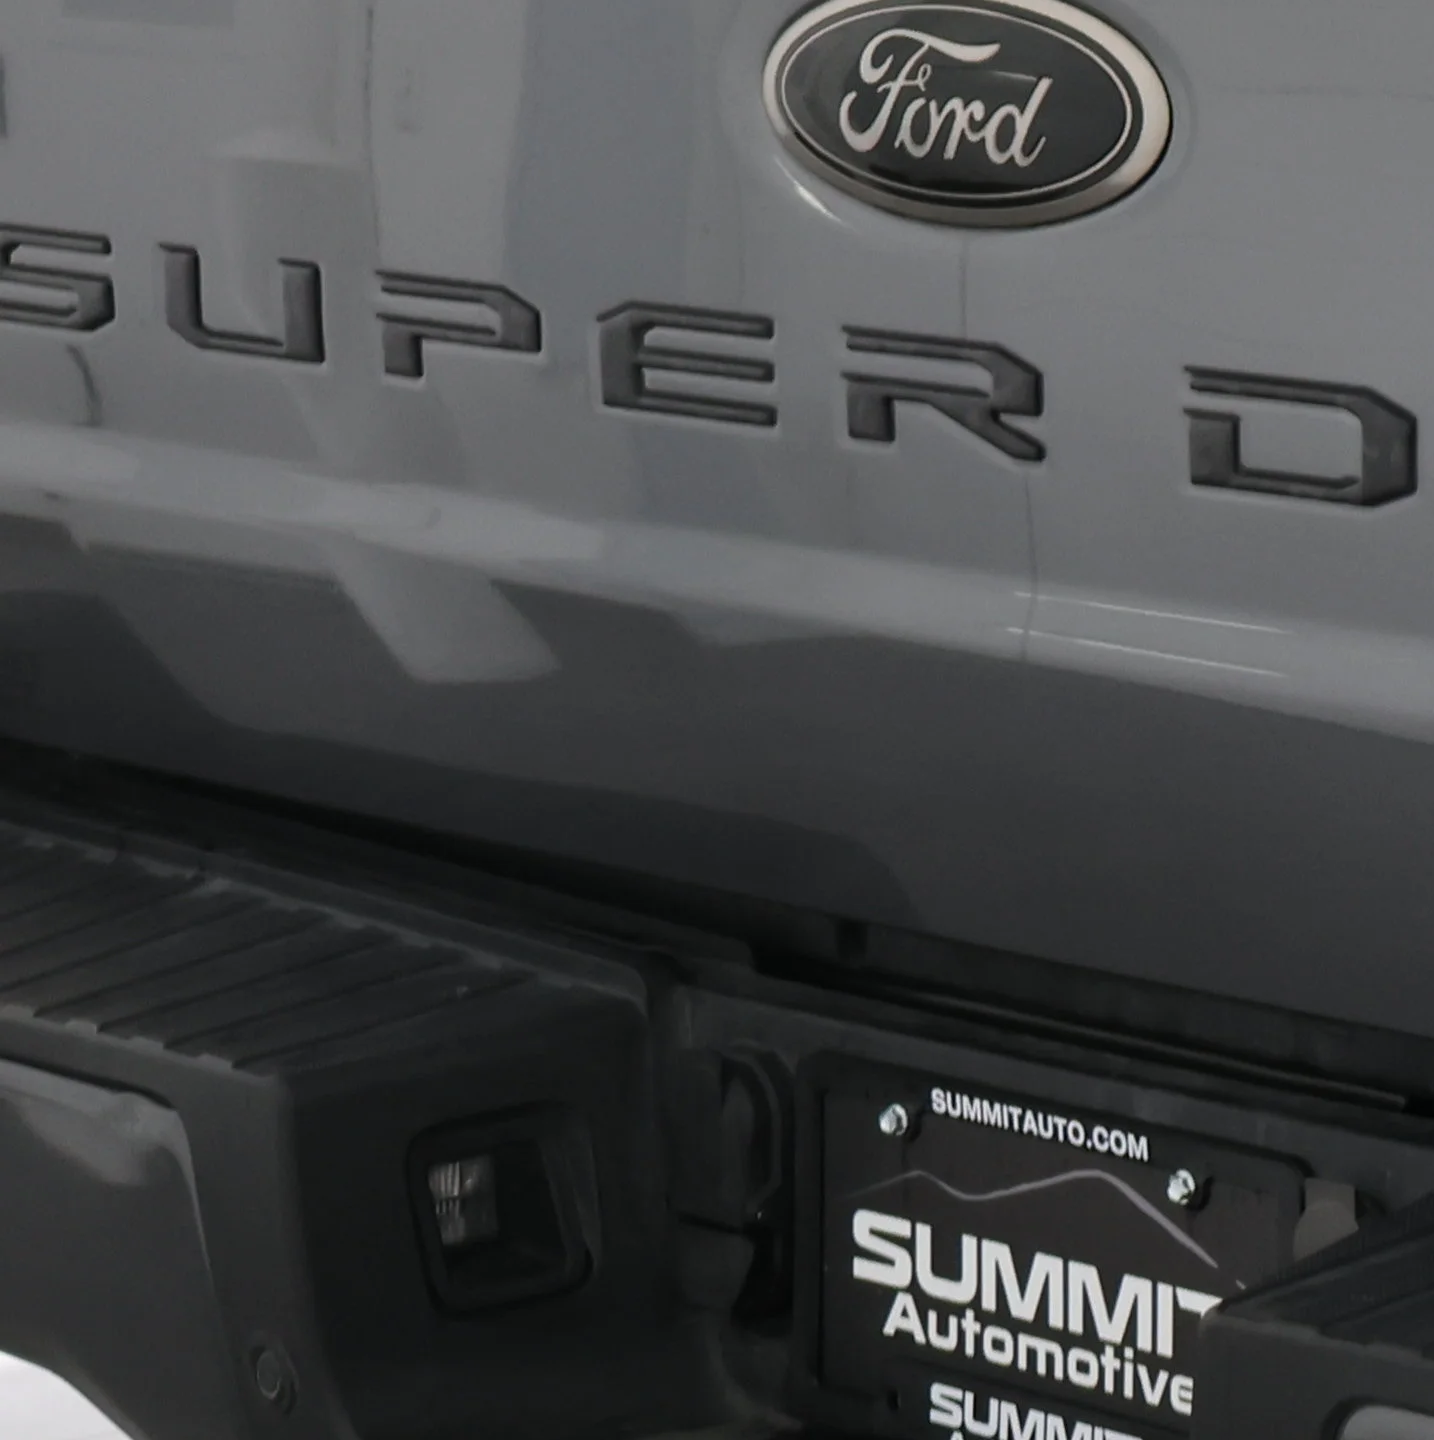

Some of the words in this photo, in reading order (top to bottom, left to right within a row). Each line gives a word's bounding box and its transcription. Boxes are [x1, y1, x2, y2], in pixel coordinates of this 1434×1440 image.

[839, 28, 1054, 168] Ford
[0, 222, 1047, 465] SUPER
[931, 1087, 1150, 1162] SUMMITAUTO.COM
[882, 1291, 1195, 1416] Automotive
